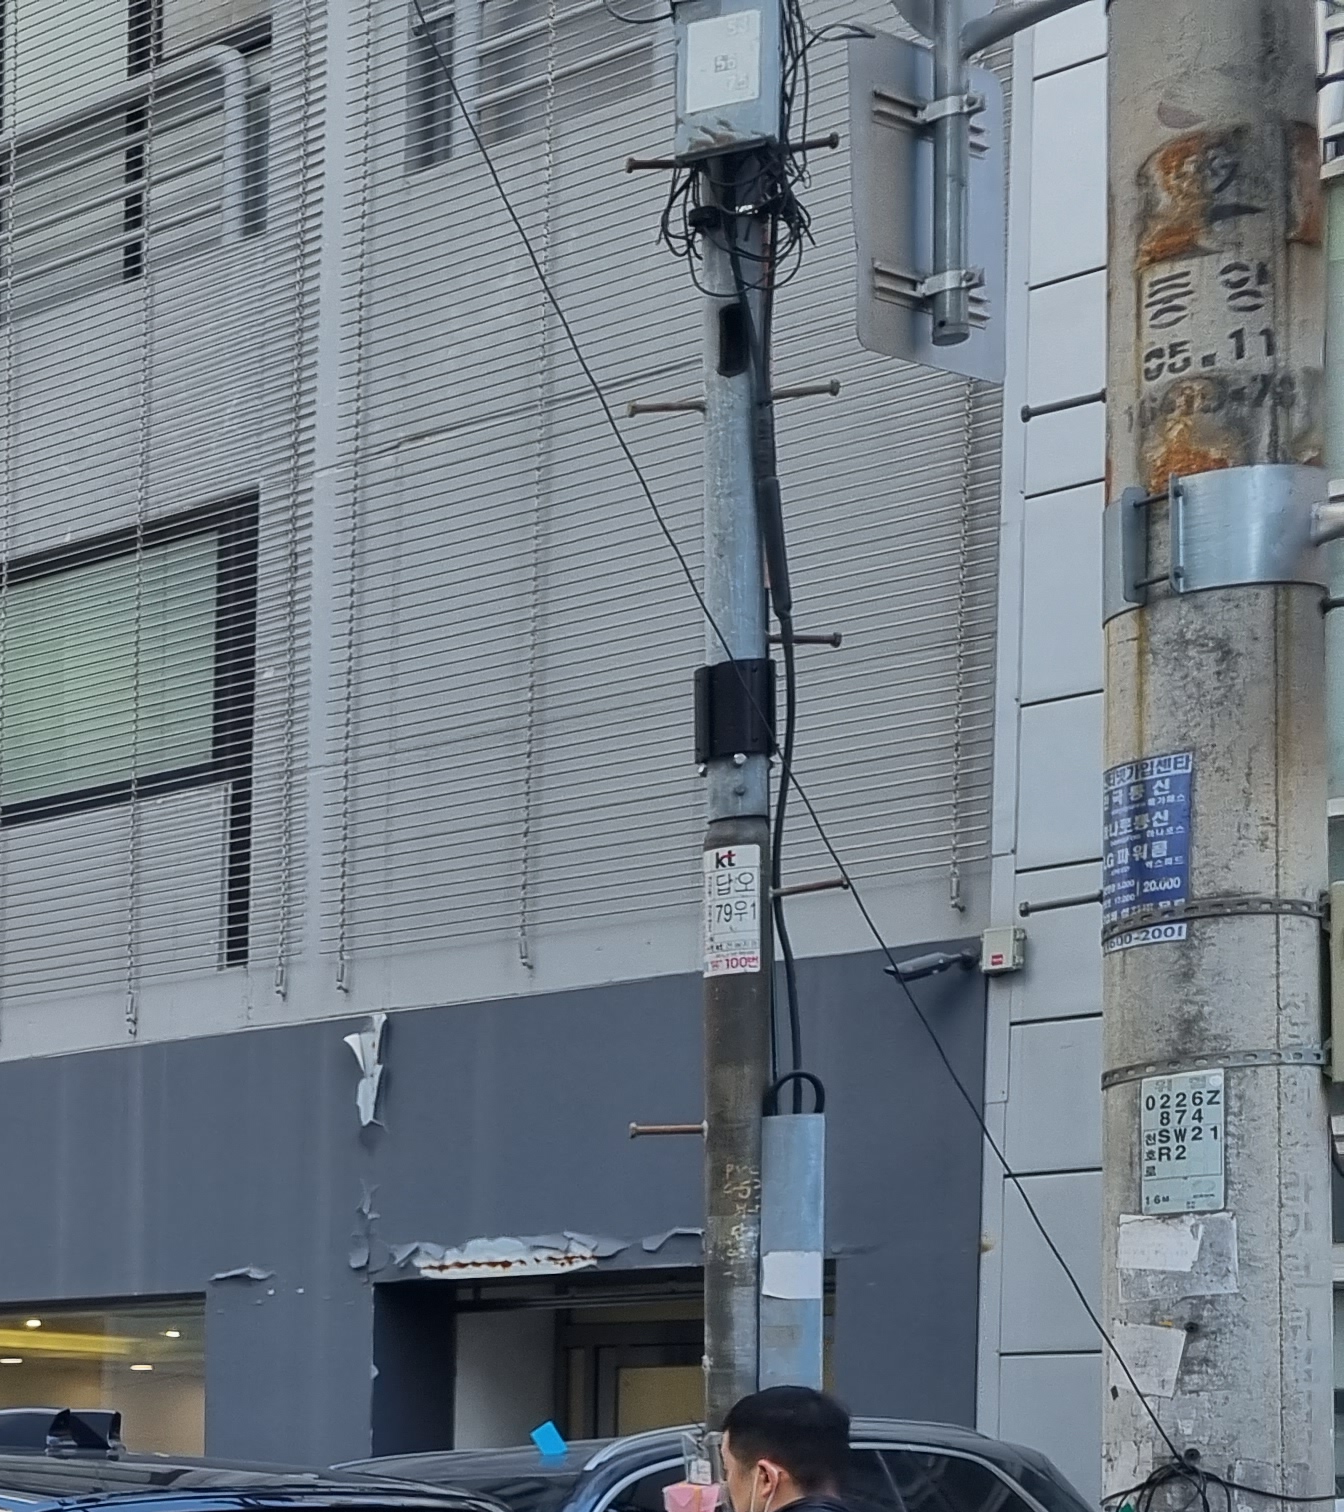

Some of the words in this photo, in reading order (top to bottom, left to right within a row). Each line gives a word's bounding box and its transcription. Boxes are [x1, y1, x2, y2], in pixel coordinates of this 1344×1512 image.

[715, 850, 736, 869] kt
[1145, 1090, 1221, 1111] 0226Z
[1159, 1108, 1204, 1126] 874
[1158, 1145, 1187, 1162] R2
